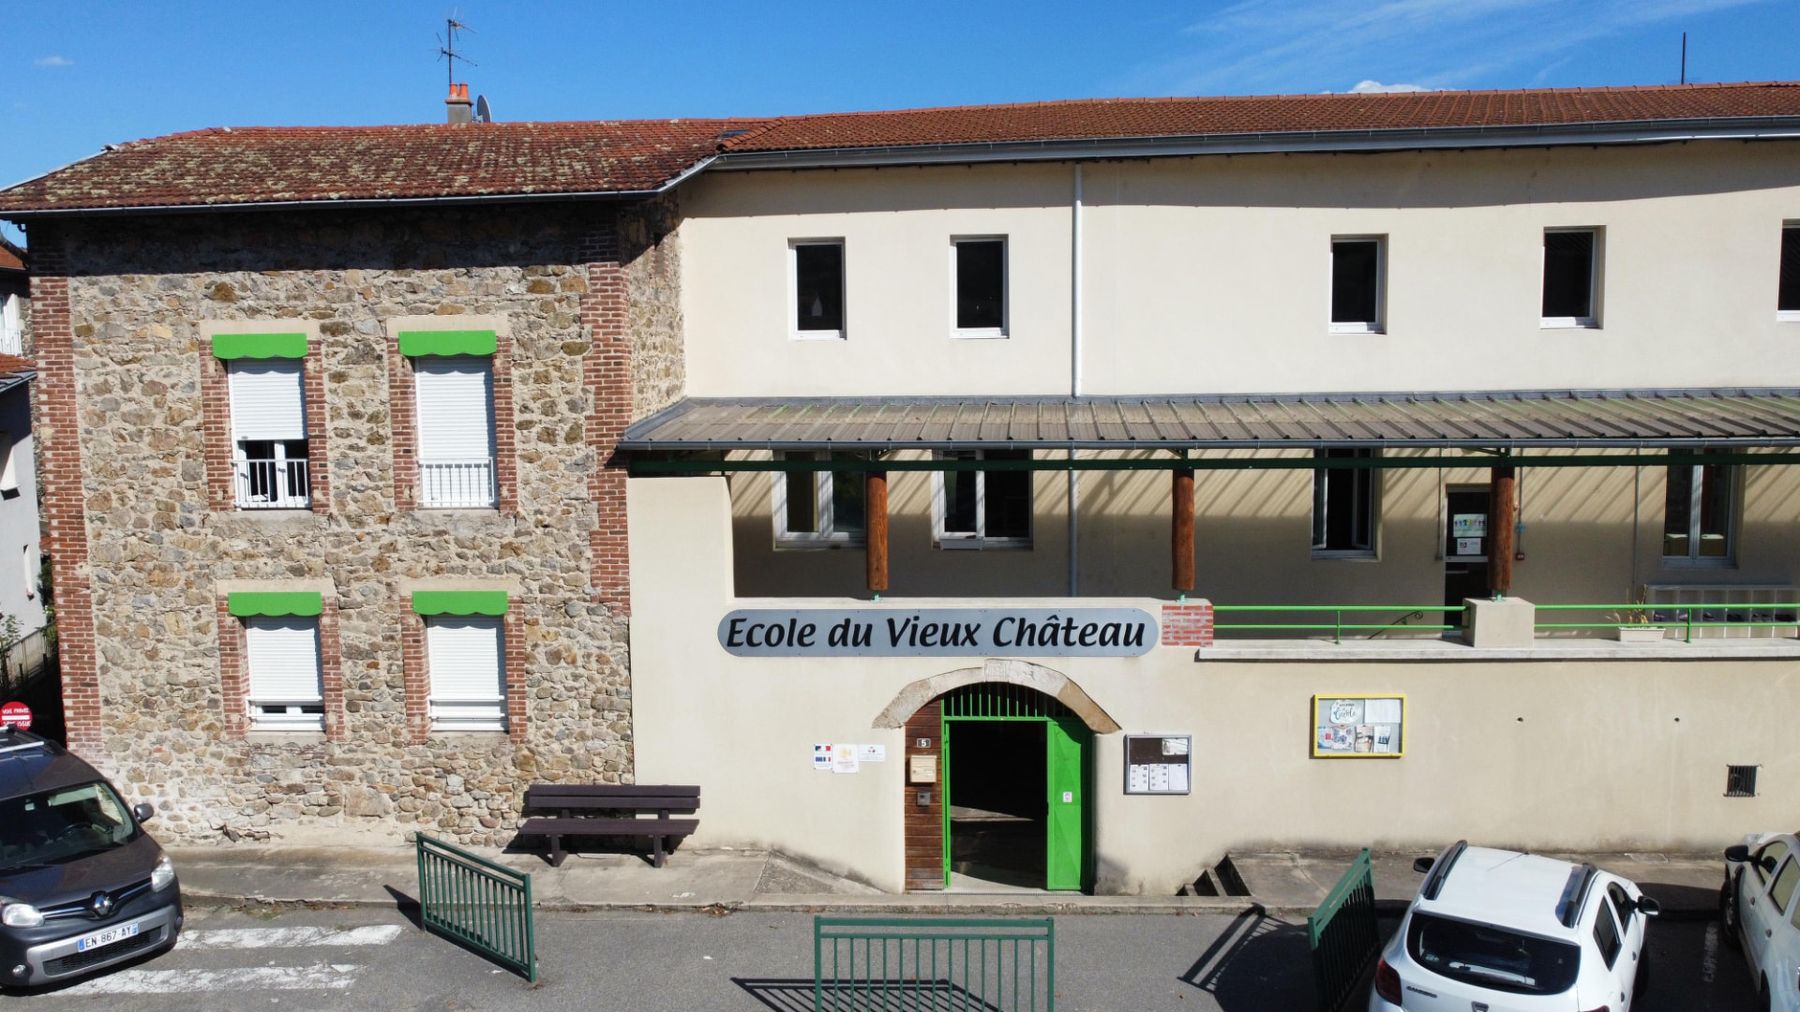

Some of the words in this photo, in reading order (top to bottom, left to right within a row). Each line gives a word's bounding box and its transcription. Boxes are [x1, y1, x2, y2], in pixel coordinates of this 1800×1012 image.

[726, 617, 816, 648] Ecole
[828, 617, 874, 648] du
[886, 616, 982, 648] Vieux
[992, 614, 1146, 648] Château
[921, 739, 927, 747] 5
